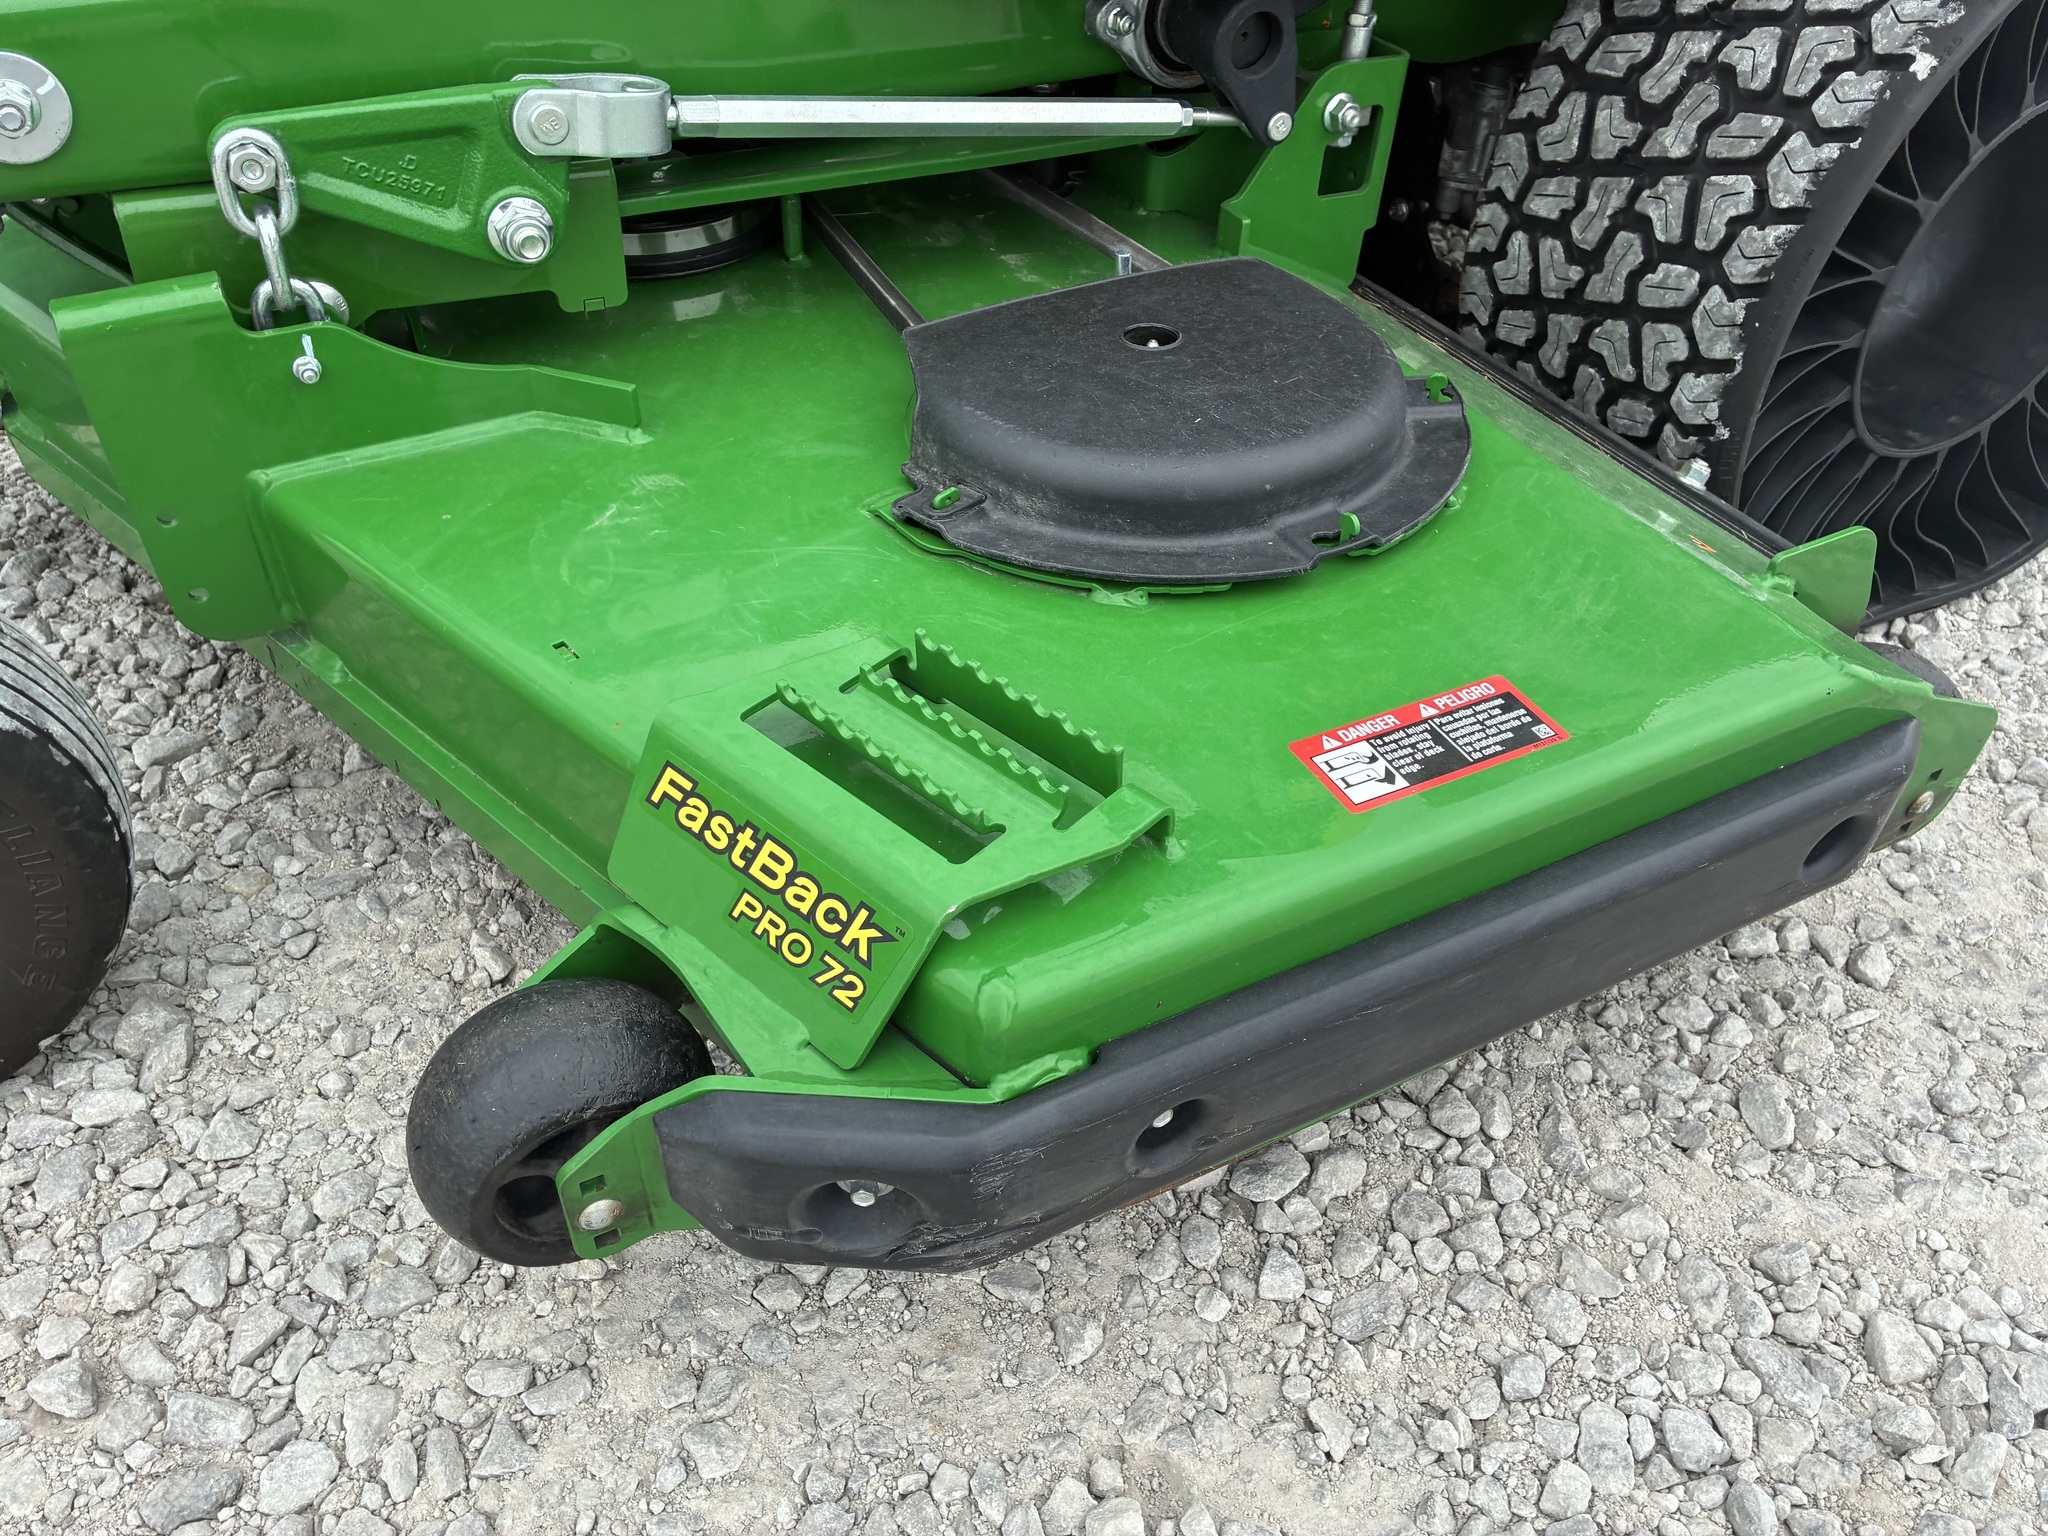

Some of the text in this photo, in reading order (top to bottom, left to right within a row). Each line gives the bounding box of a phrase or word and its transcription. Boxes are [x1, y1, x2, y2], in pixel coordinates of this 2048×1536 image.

[342, 156, 446, 201] TCU25971
[1433, 683, 1496, 710] PELIGRO
[1432, 698, 1505, 725] Para evitar lesiones
[1441, 708, 1502, 732] causadas por las
[1484, 708, 1527, 727] mantenerse
[1337, 714, 1401, 742] DANGER
[1383, 730, 1407, 743] avoid
[1405, 723, 1431, 735] injury
[1456, 715, 1533, 746] alejado del borde de
[1377, 732, 1432, 754] from rotating
[1384, 740, 1435, 760] blades, stay
[1462, 731, 1514, 752] la plataforma
[1470, 744, 1506, 760] de corte.
[1392, 745, 1445, 768] clear of deck
[1399, 763, 1425, 775] edge.
[648, 762, 890, 968] FastBack
[730, 890, 865, 1011] PRO 72
